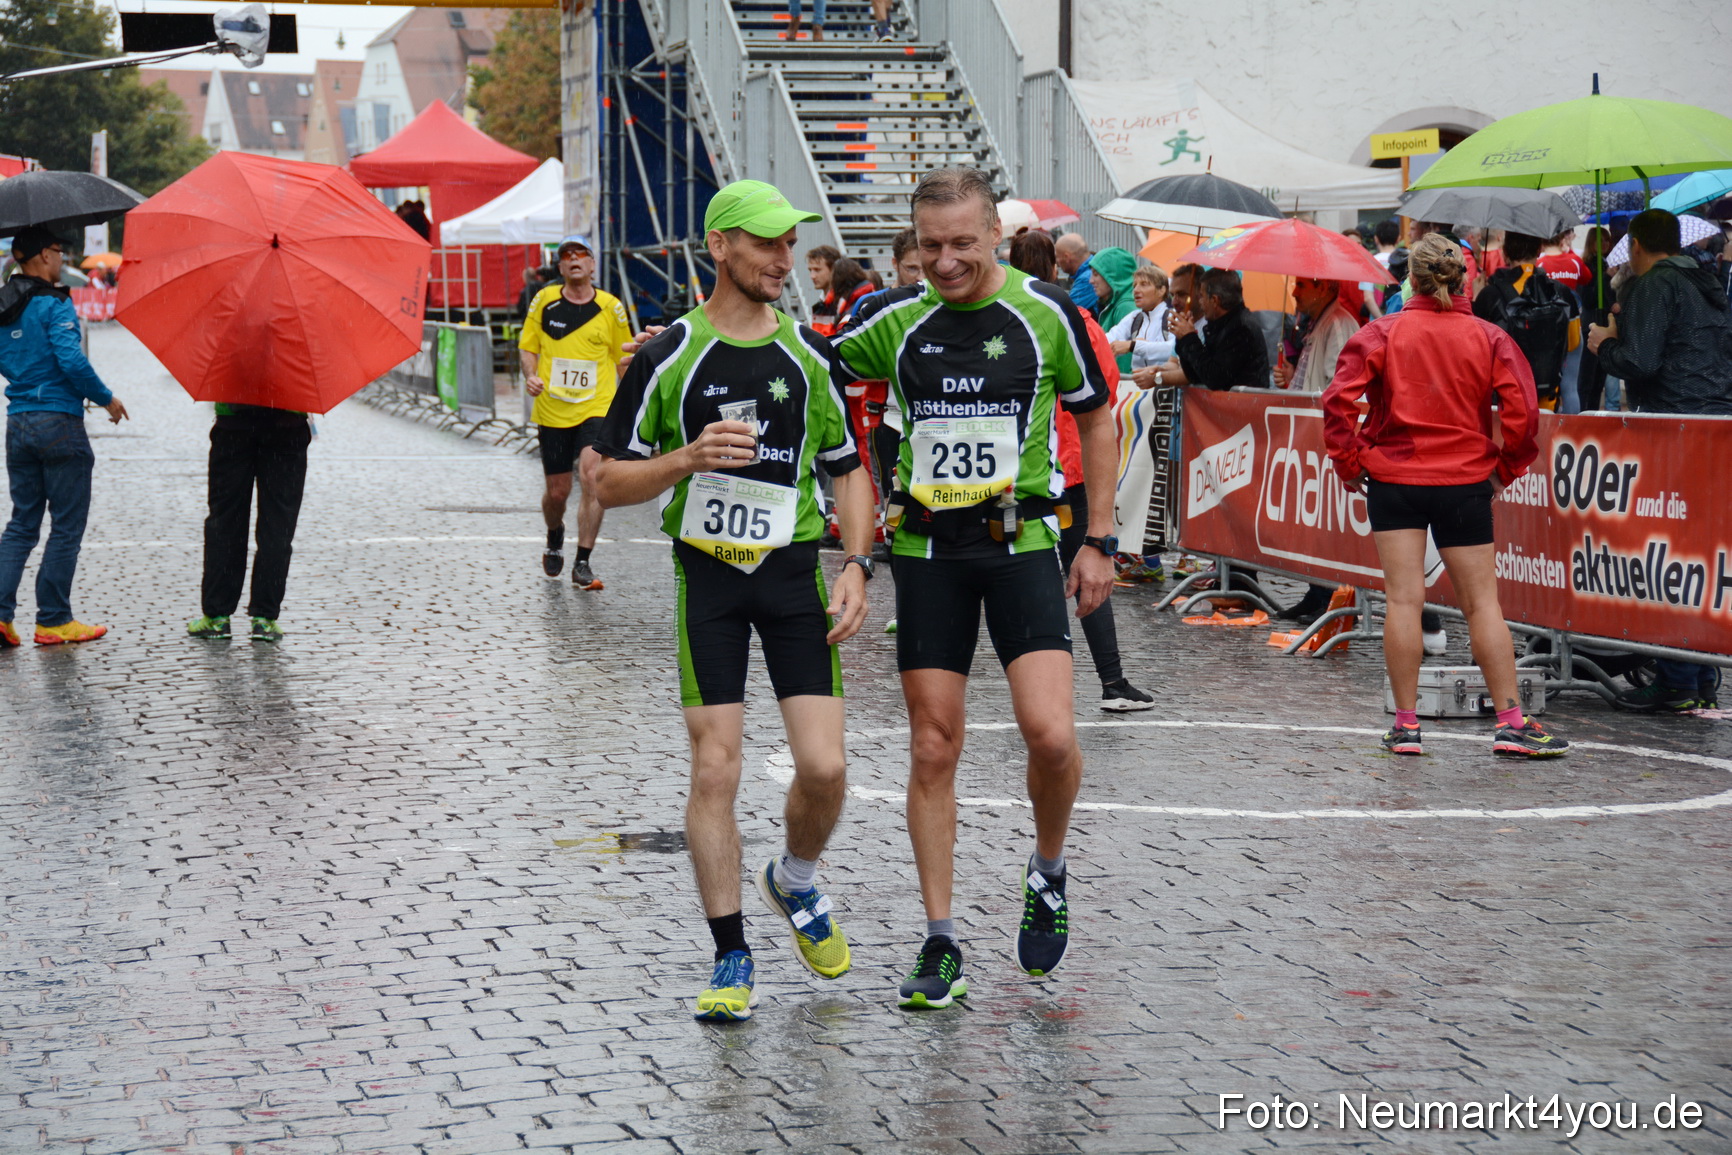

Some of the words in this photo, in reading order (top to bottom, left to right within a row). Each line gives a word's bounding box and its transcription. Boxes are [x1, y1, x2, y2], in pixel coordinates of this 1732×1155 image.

[1382, 138, 1428, 152] Infopoint
[561, 370, 589, 387] 176
[942, 377, 985, 393] DAV
[913, 398, 1022, 417] Röthenbach
[955, 420, 1007, 434] BOCK
[931, 442, 996, 480] 235
[1215, 440, 1249, 489] NEUE
[1499, 465, 1549, 508] eisten
[1553, 442, 1639, 513] 80er
[1636, 491, 1664, 519] und
[1666, 492, 1688, 520] die
[695, 482, 730, 495] NeuerMarkt
[735, 481, 786, 503] BOCK
[932, 486, 993, 504] Reinhard
[703, 498, 772, 541] 305
[714, 545, 755, 564] Ralph
[1494, 542, 1566, 590] schönsten
[1571, 535, 1706, 607] aktuellen
